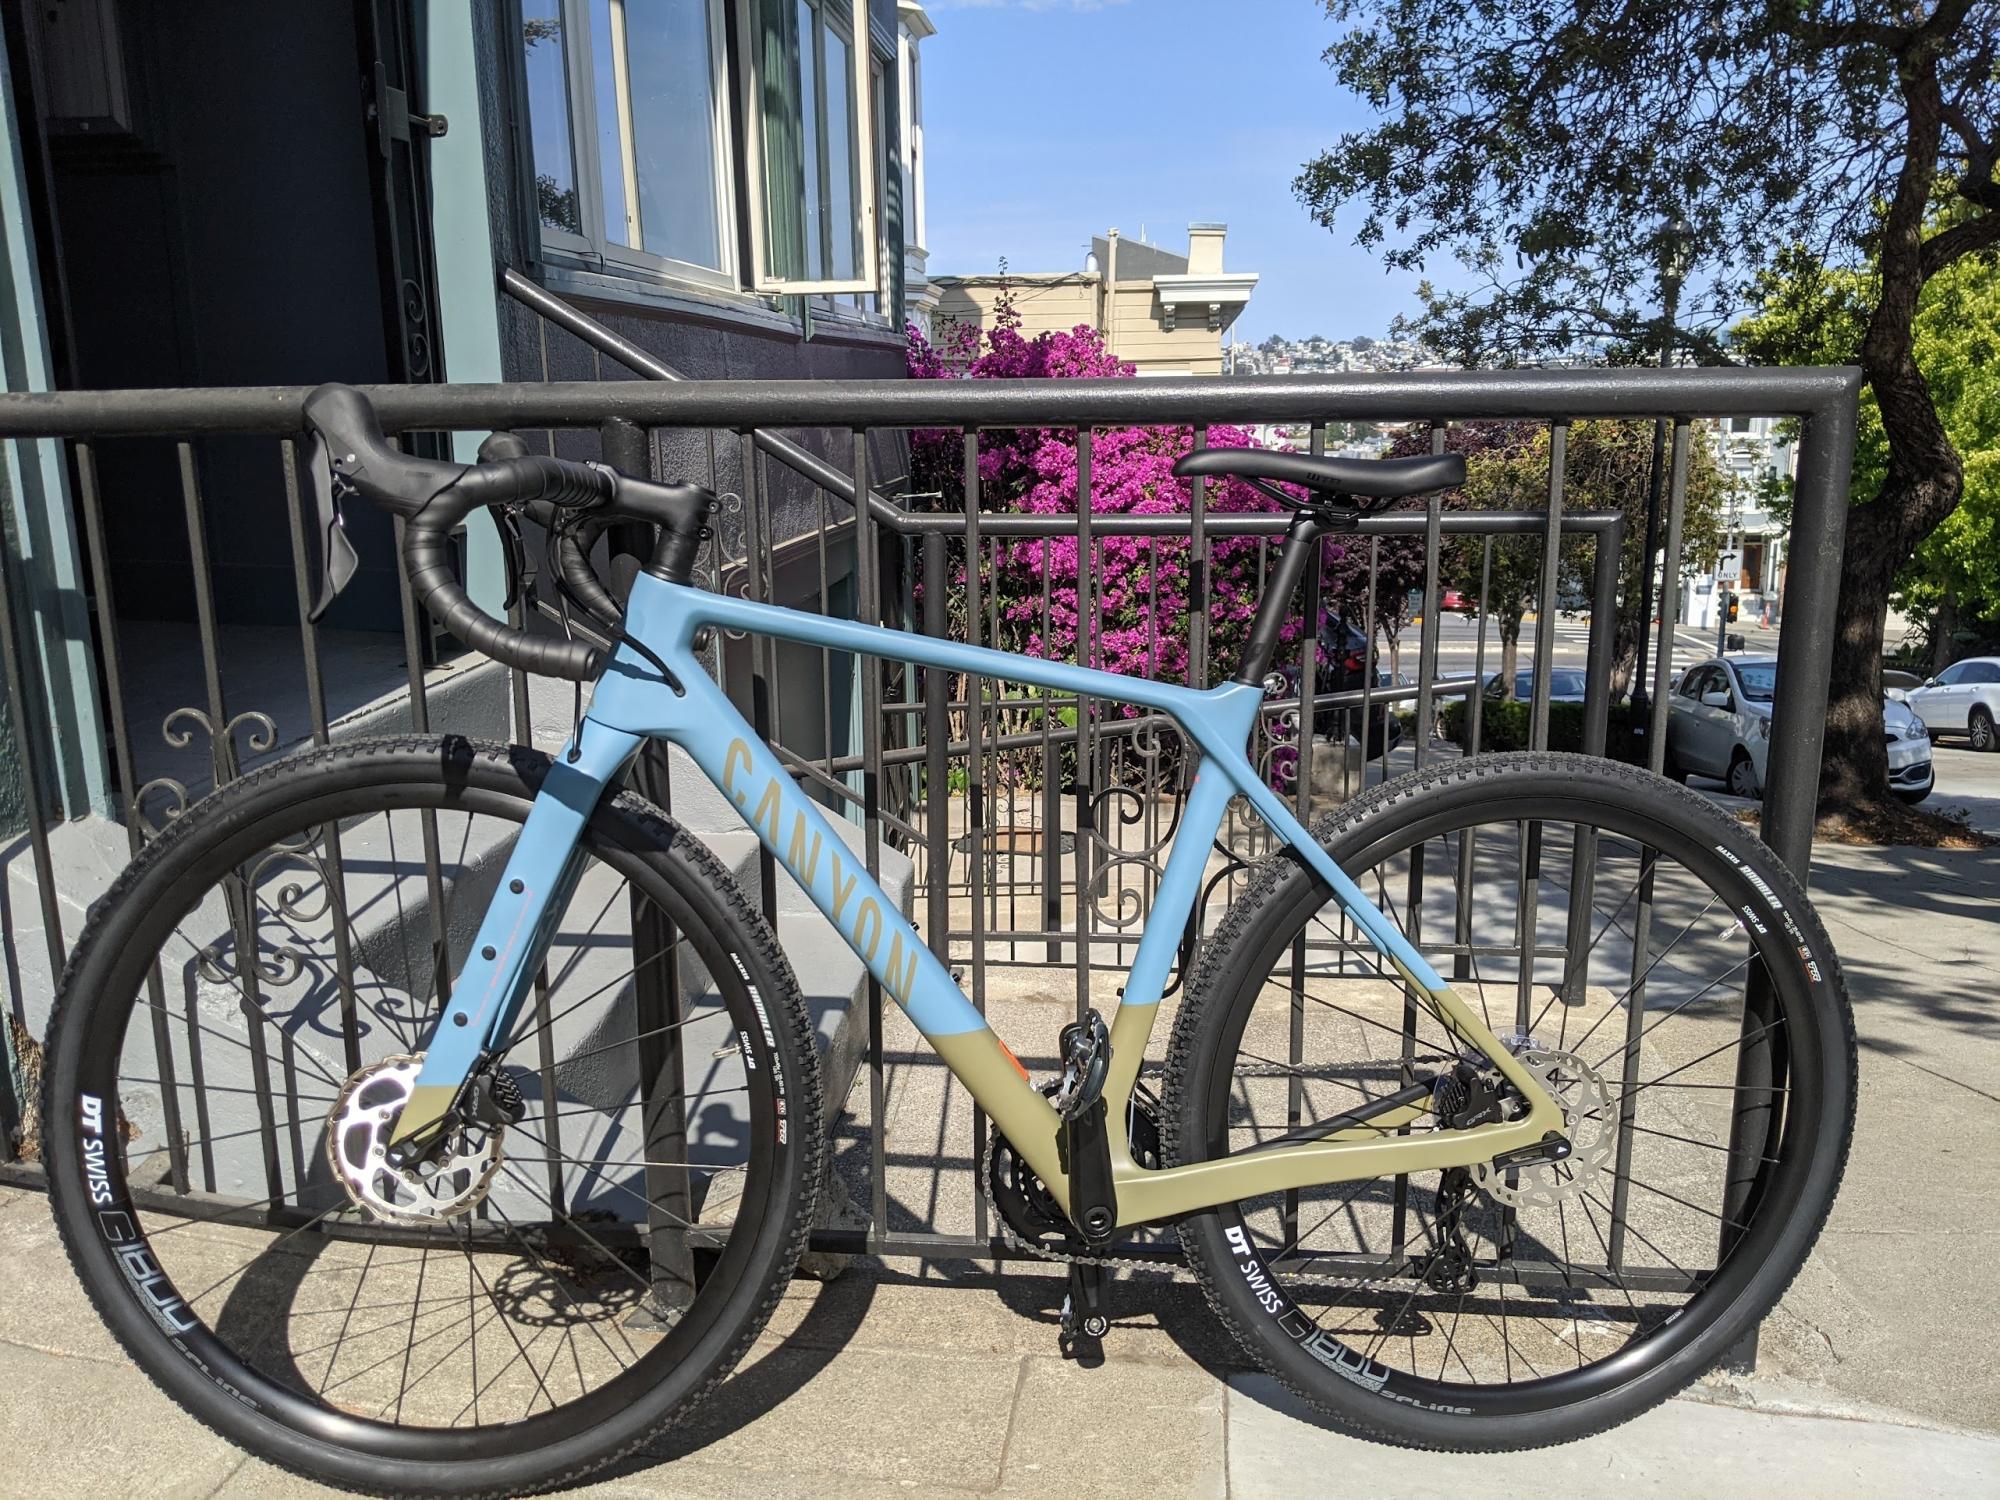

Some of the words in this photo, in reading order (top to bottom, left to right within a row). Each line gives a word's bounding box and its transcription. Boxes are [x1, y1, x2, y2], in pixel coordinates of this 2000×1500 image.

[1715, 845, 1740, 864] MAXXIS
[722, 737, 918, 1008] CANYON
[1741, 905, 1760, 923] SWISS
[1754, 923, 1768, 934] DT
[730, 952, 750, 980] MAXXIS
[740, 1030, 753, 1054] SWISS
[746, 1055, 756, 1069] DT
[82, 1094, 102, 1134] DT
[83, 1138, 113, 1205] SWISS
[1224, 1225, 1251, 1256] DT
[1240, 1260, 1283, 1313] SWISS
